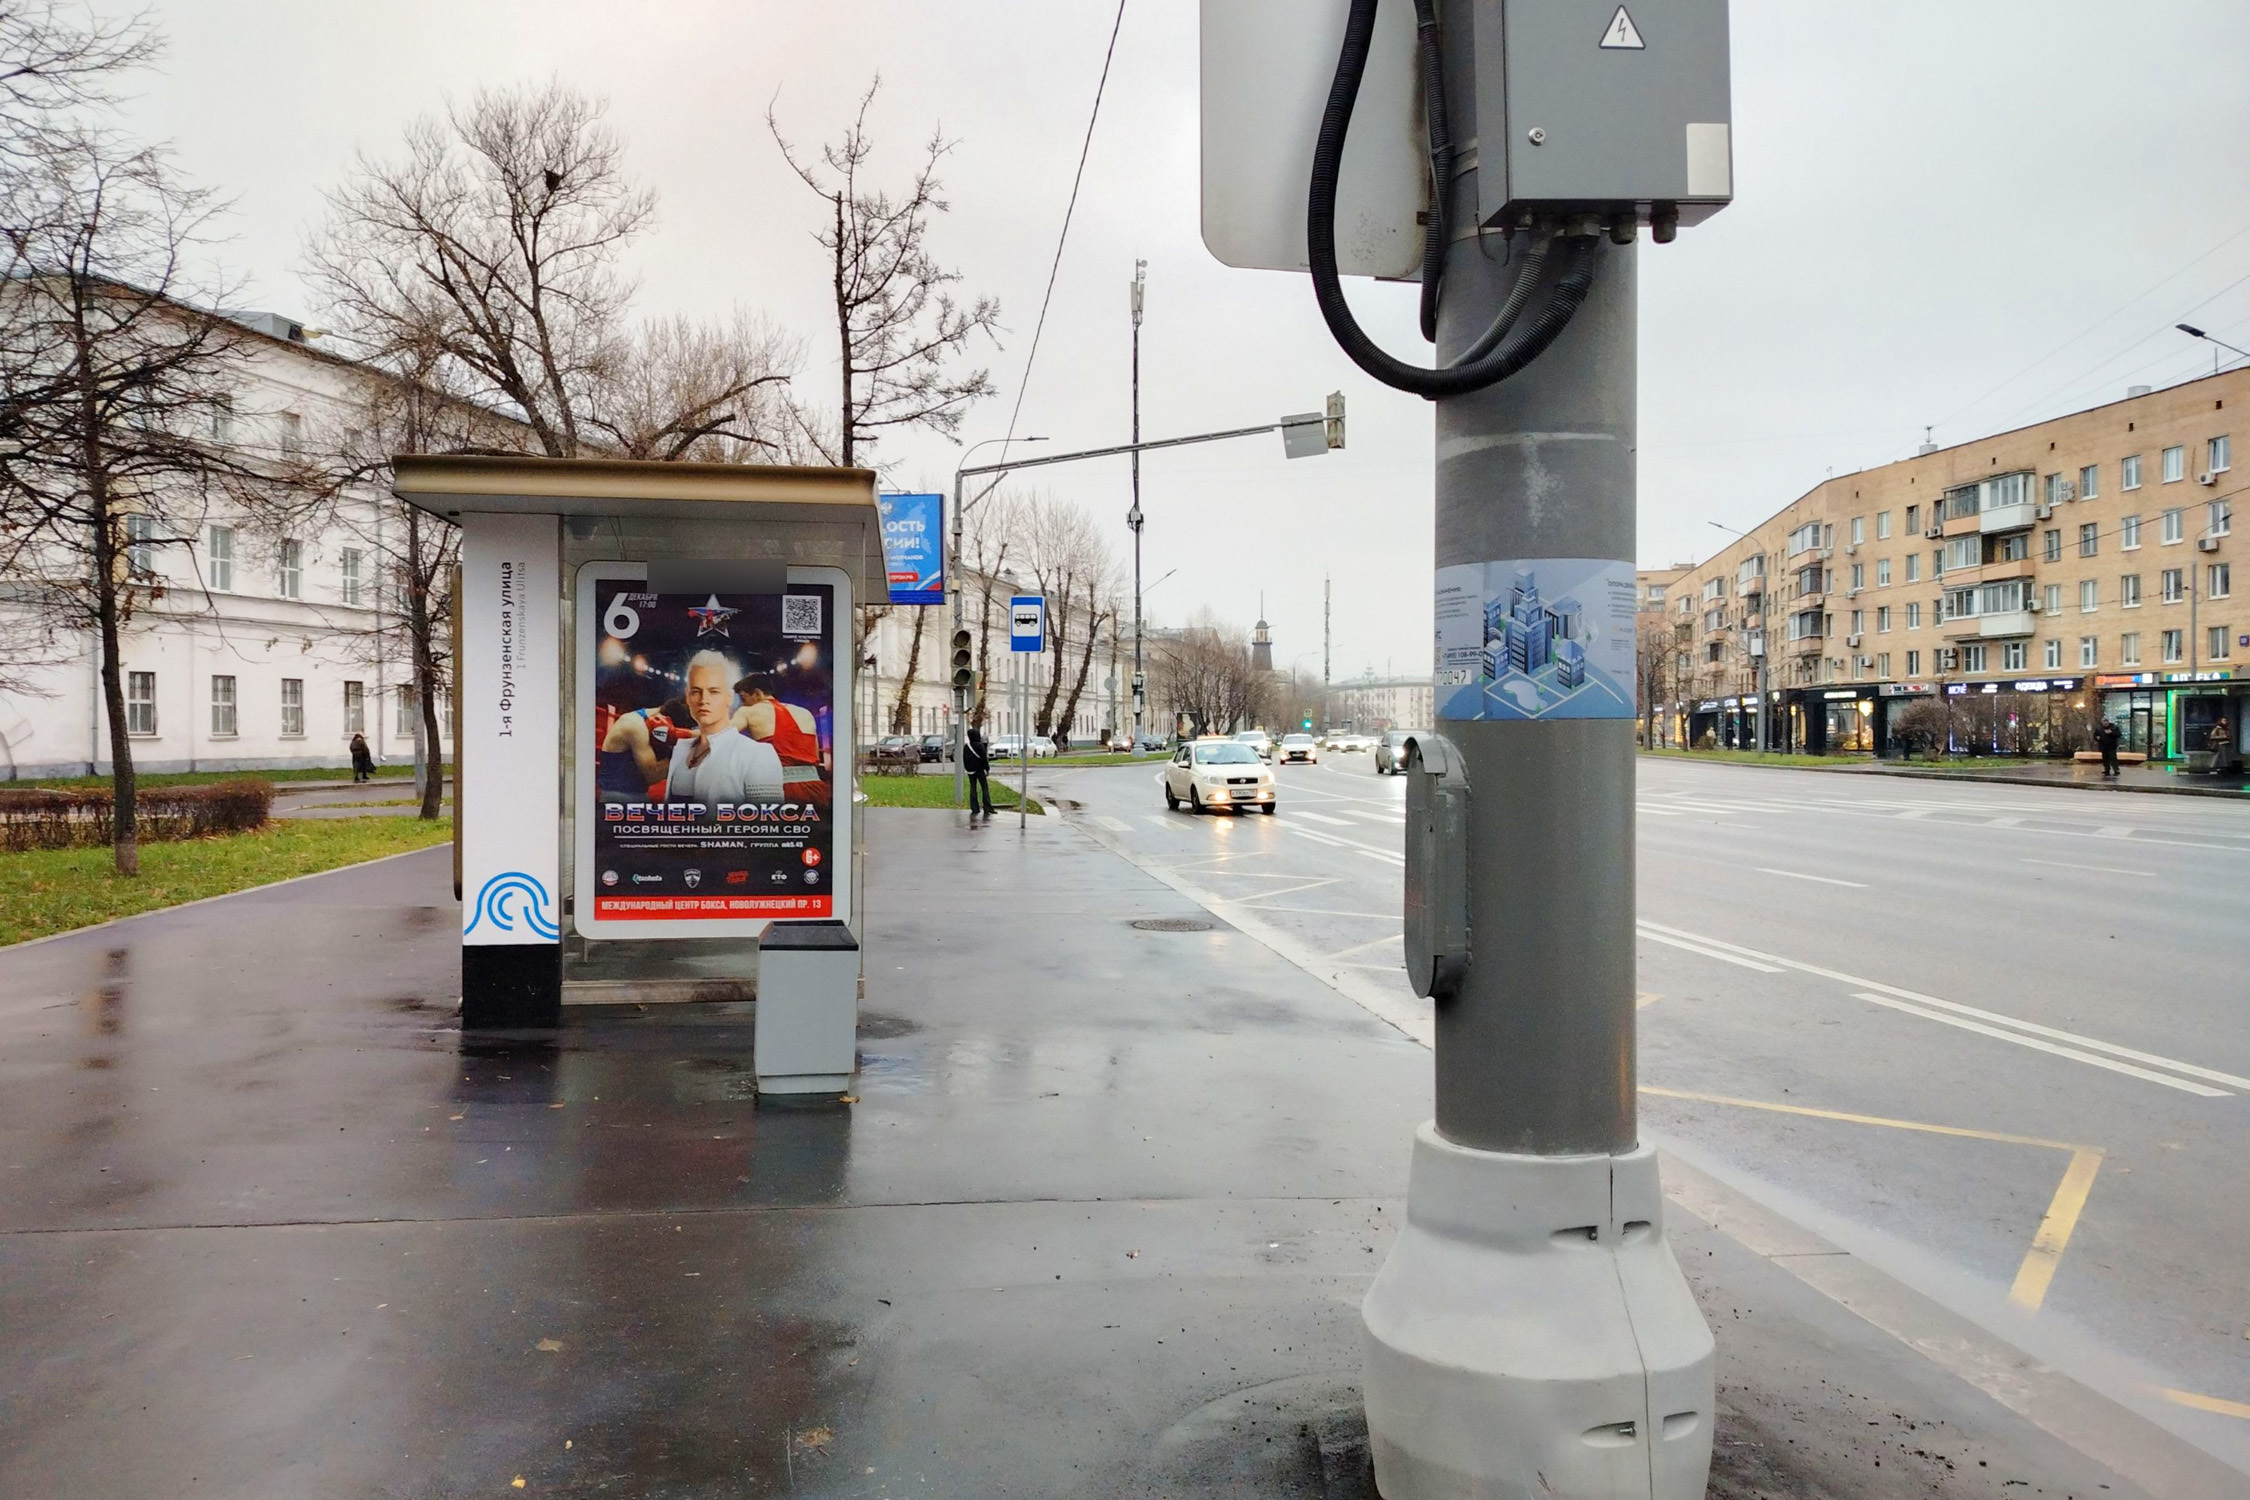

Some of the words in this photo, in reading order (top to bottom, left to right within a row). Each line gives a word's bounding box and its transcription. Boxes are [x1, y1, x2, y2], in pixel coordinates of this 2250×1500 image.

[883, 520, 925, 533] ОСТЬ
[884, 537, 920, 549] СИИ!
[517, 562, 526, 591] Ulitsa
[501, 561, 515, 607] улица
[628, 593, 658, 601] ДЕКАБРЯ
[639, 601, 657, 609] 17:00
[604, 592, 640, 639] 6
[517, 594, 527, 661] Frunzenskaya
[499, 611, 515, 712] Фрунзенская
[2171, 672, 2221, 682] АПЕКА
[499, 716, 513, 737] 1-я
[604, 803, 707, 822] ВЕЧЕР
[717, 803, 820, 822] БОКСА
[613, 824, 722, 835] ПОСВЯЩЕННЫЙ
[727, 825, 779, 834] ГЕРОЯМ
[784, 825, 811, 834] СВО
[700, 841, 748, 849] SHAMAN,
[806, 849, 819, 865] 6+
[601, 899, 673, 911] МЕЖДУНАРОДНЫЙ
[675, 900, 699, 911] ЦЕНТР
[701, 900, 728, 910] БОКСА,
[729, 898, 796, 910] НОВОЛУЖНЕЦКИЙ
[797, 900, 810, 909] ПР.
[812, 900, 821, 908] 13
